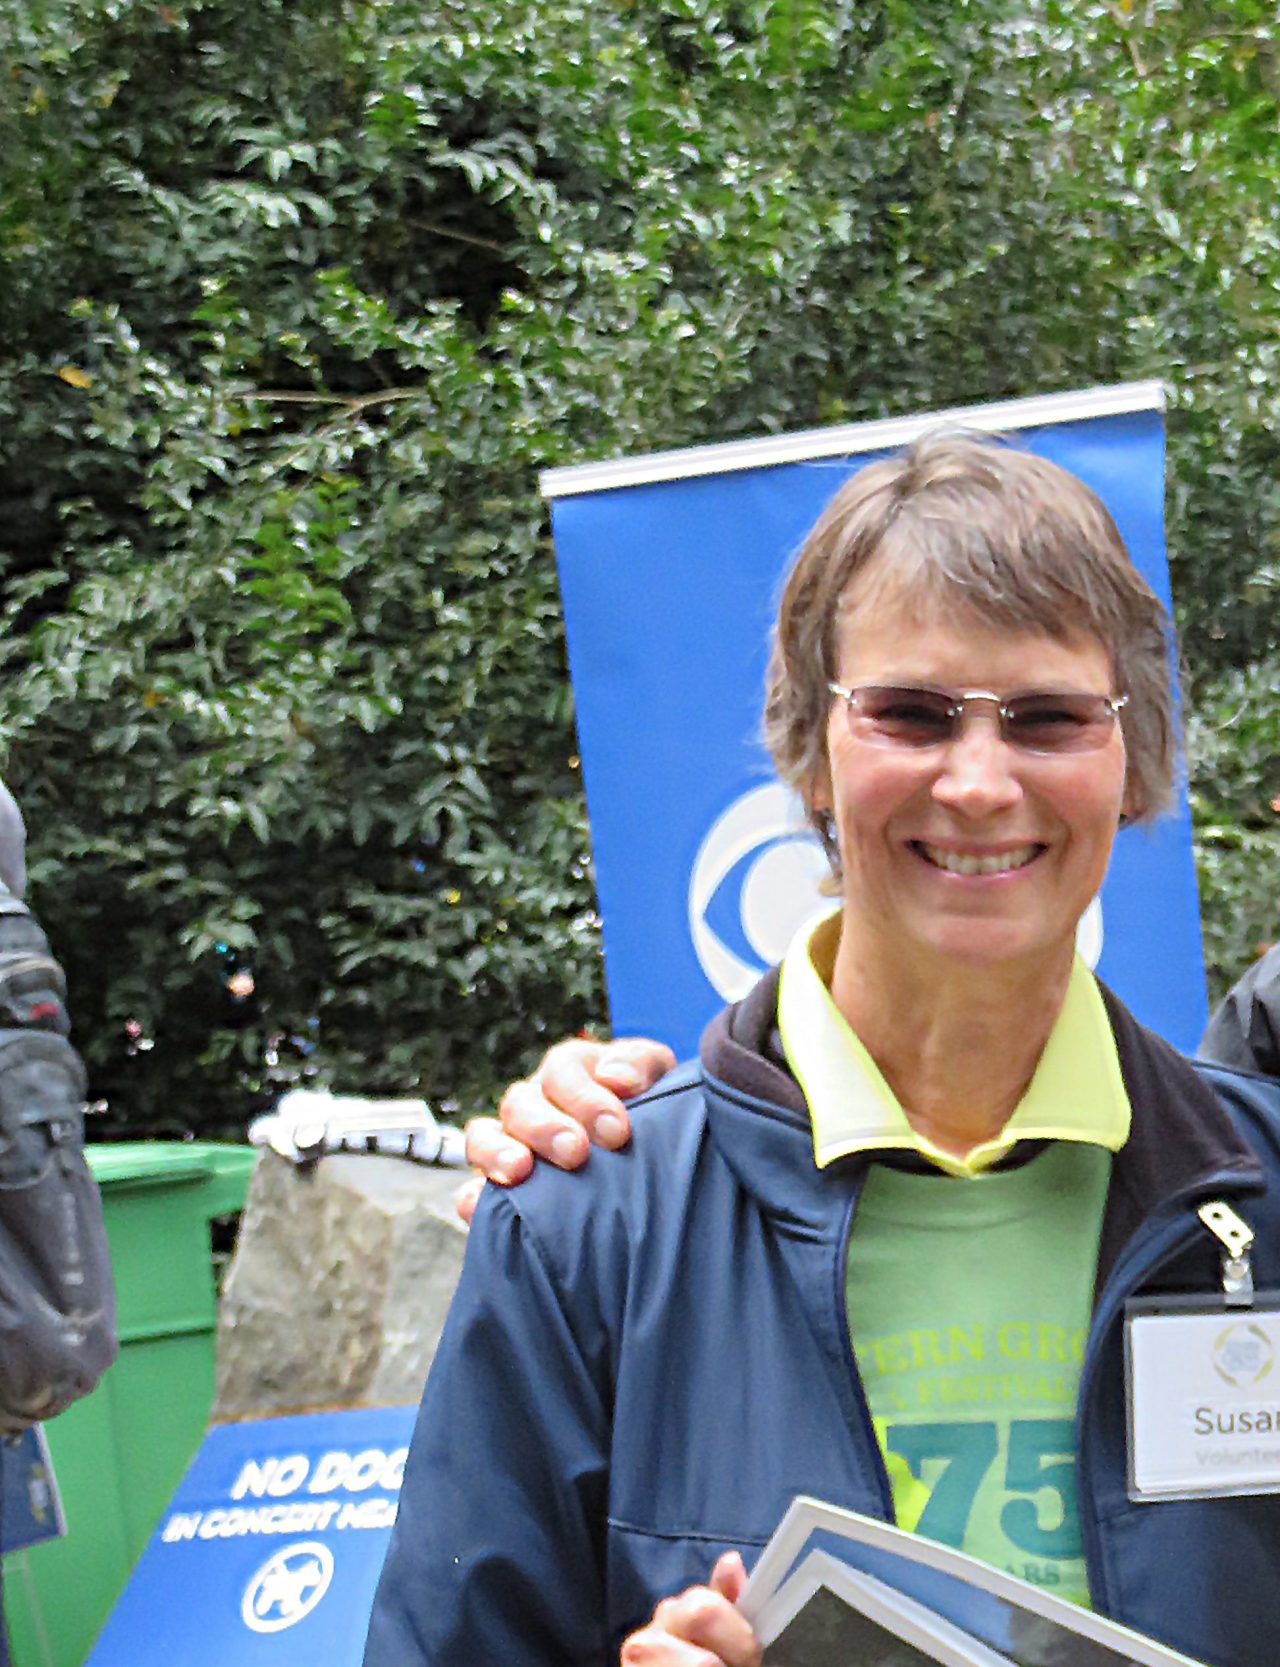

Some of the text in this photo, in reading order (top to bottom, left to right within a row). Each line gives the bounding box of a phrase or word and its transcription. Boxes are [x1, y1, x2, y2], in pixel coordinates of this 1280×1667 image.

[857, 1321, 986, 1377] ERN
[231, 1454, 310, 1501] NO
[886, 1419, 1082, 1560] 75
[161, 1513, 201, 1543] IN
